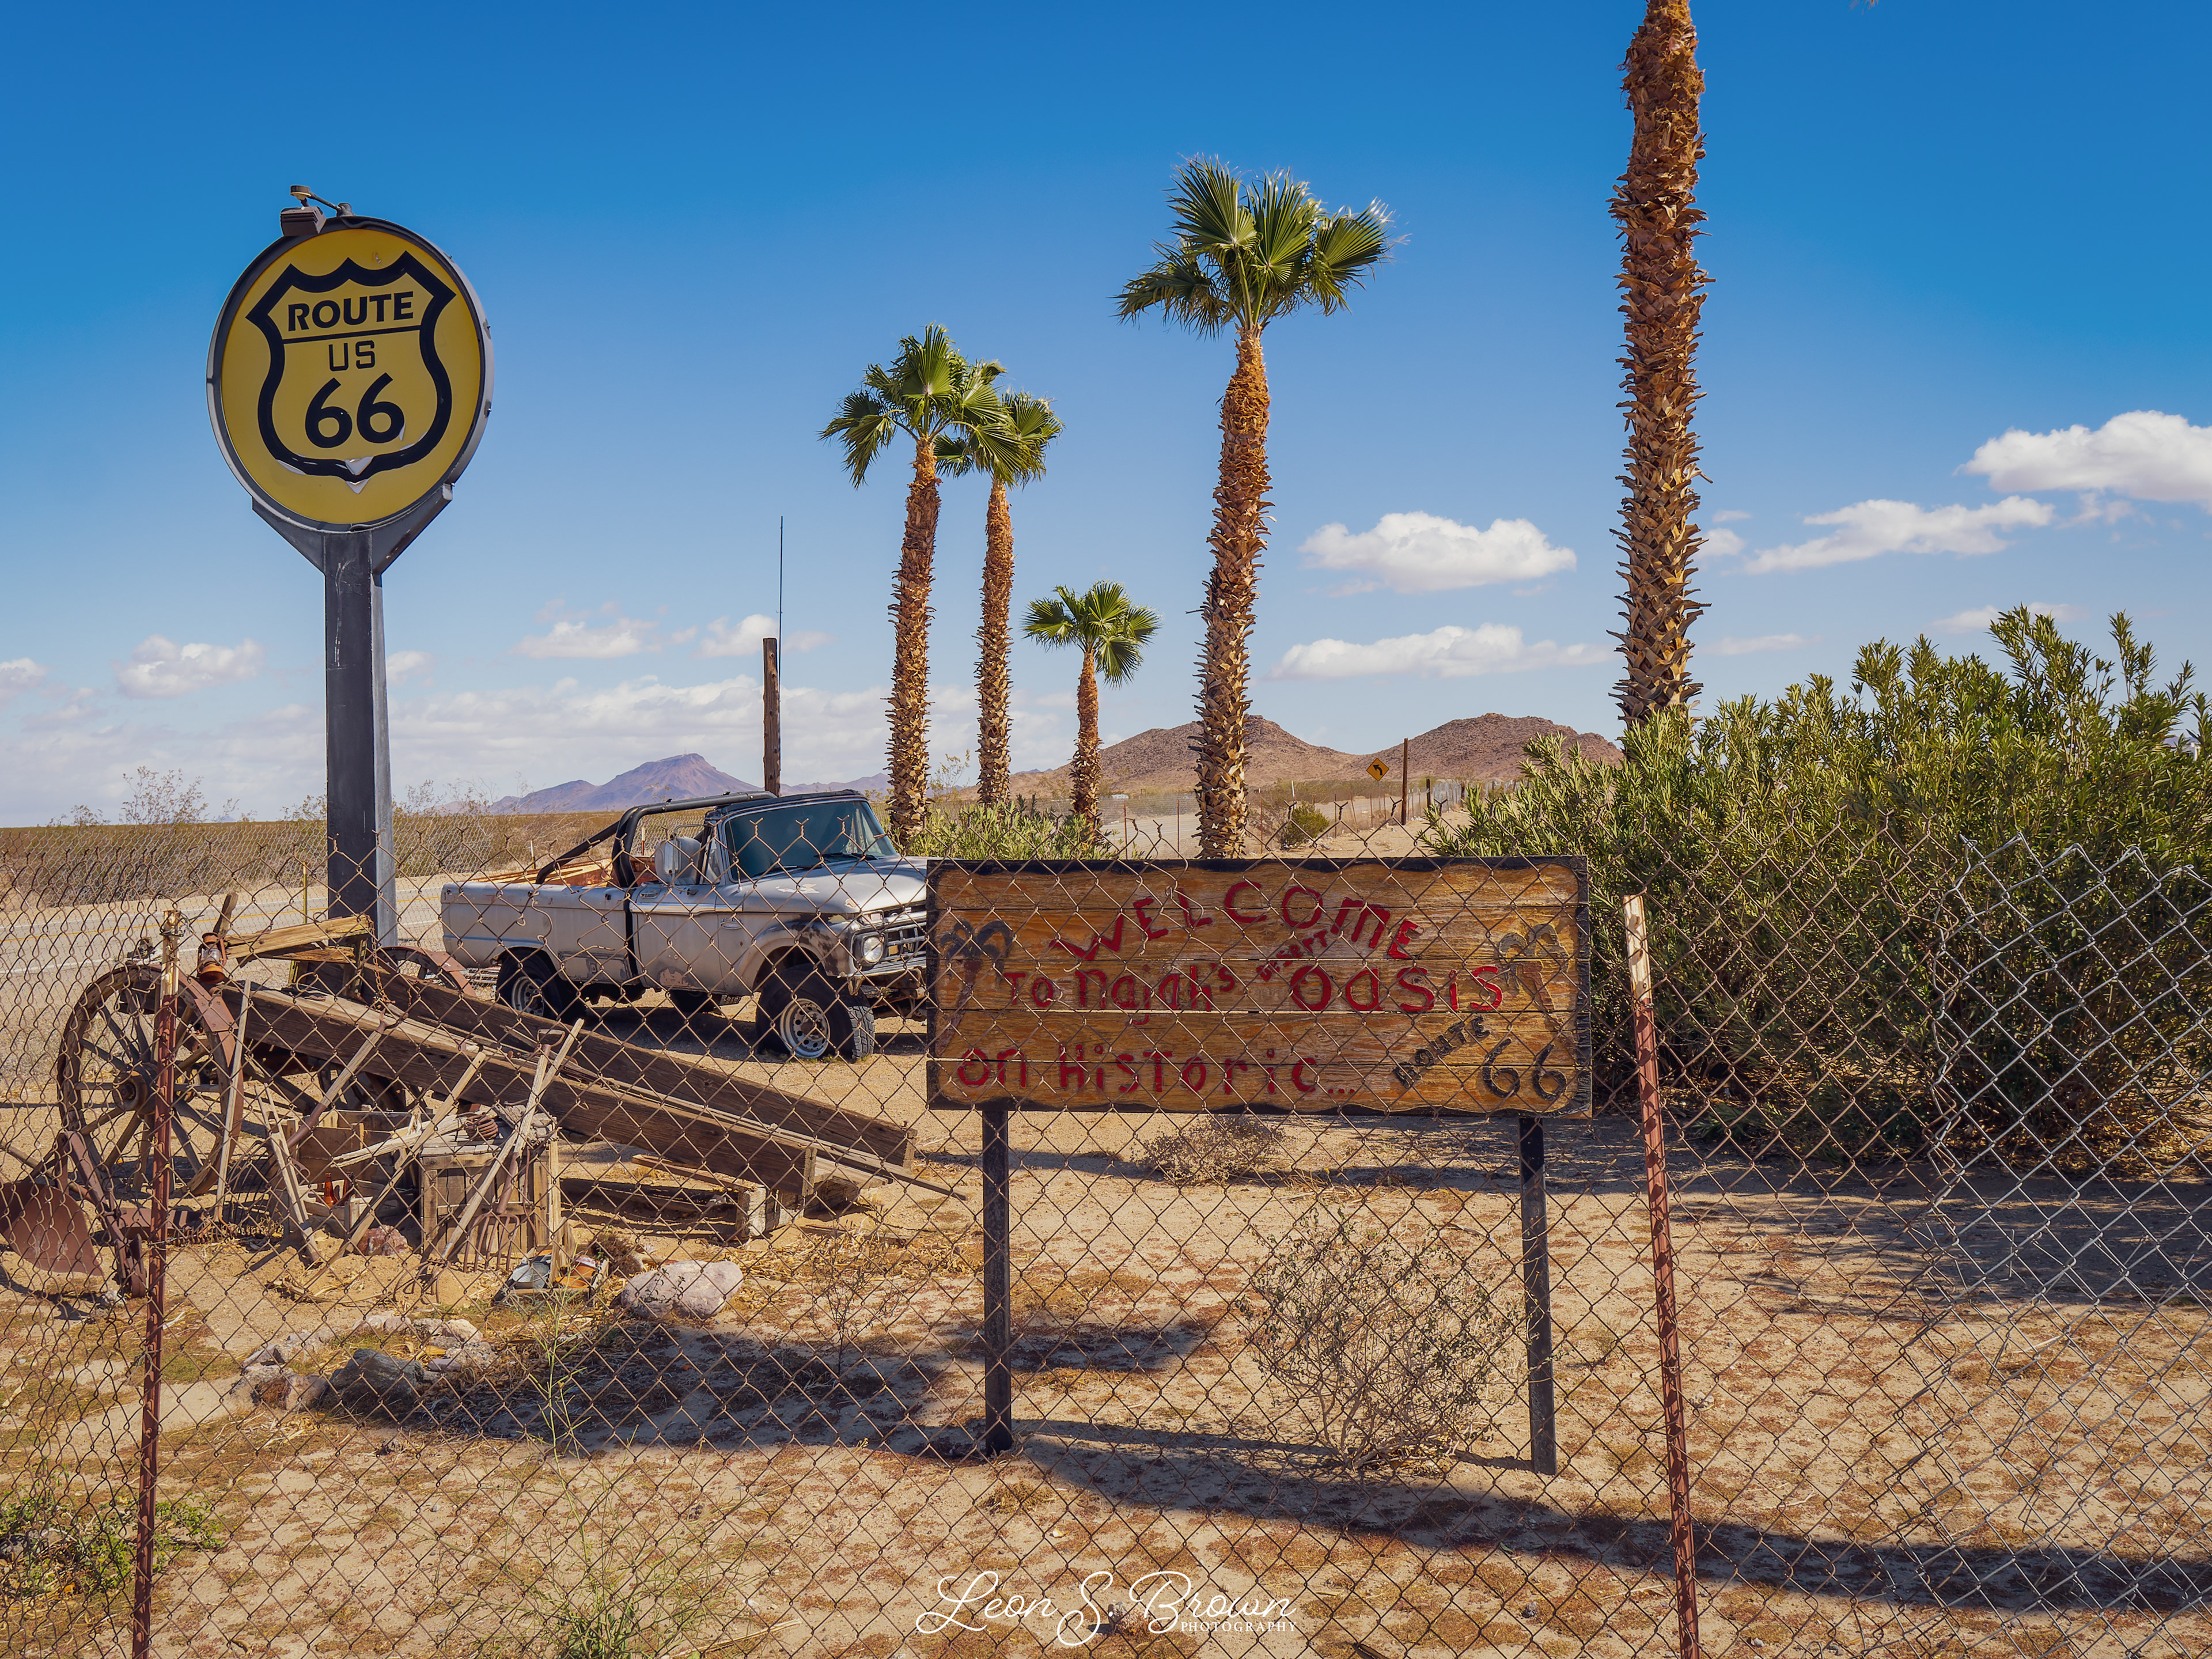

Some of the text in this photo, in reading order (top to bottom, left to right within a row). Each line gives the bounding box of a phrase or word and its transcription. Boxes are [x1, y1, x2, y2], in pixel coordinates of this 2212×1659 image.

[288, 291, 414, 331] ROUTE
[329, 340, 376, 372] US
[305, 373, 405, 448] 66
[1482, 1038, 1567, 1101] 66
